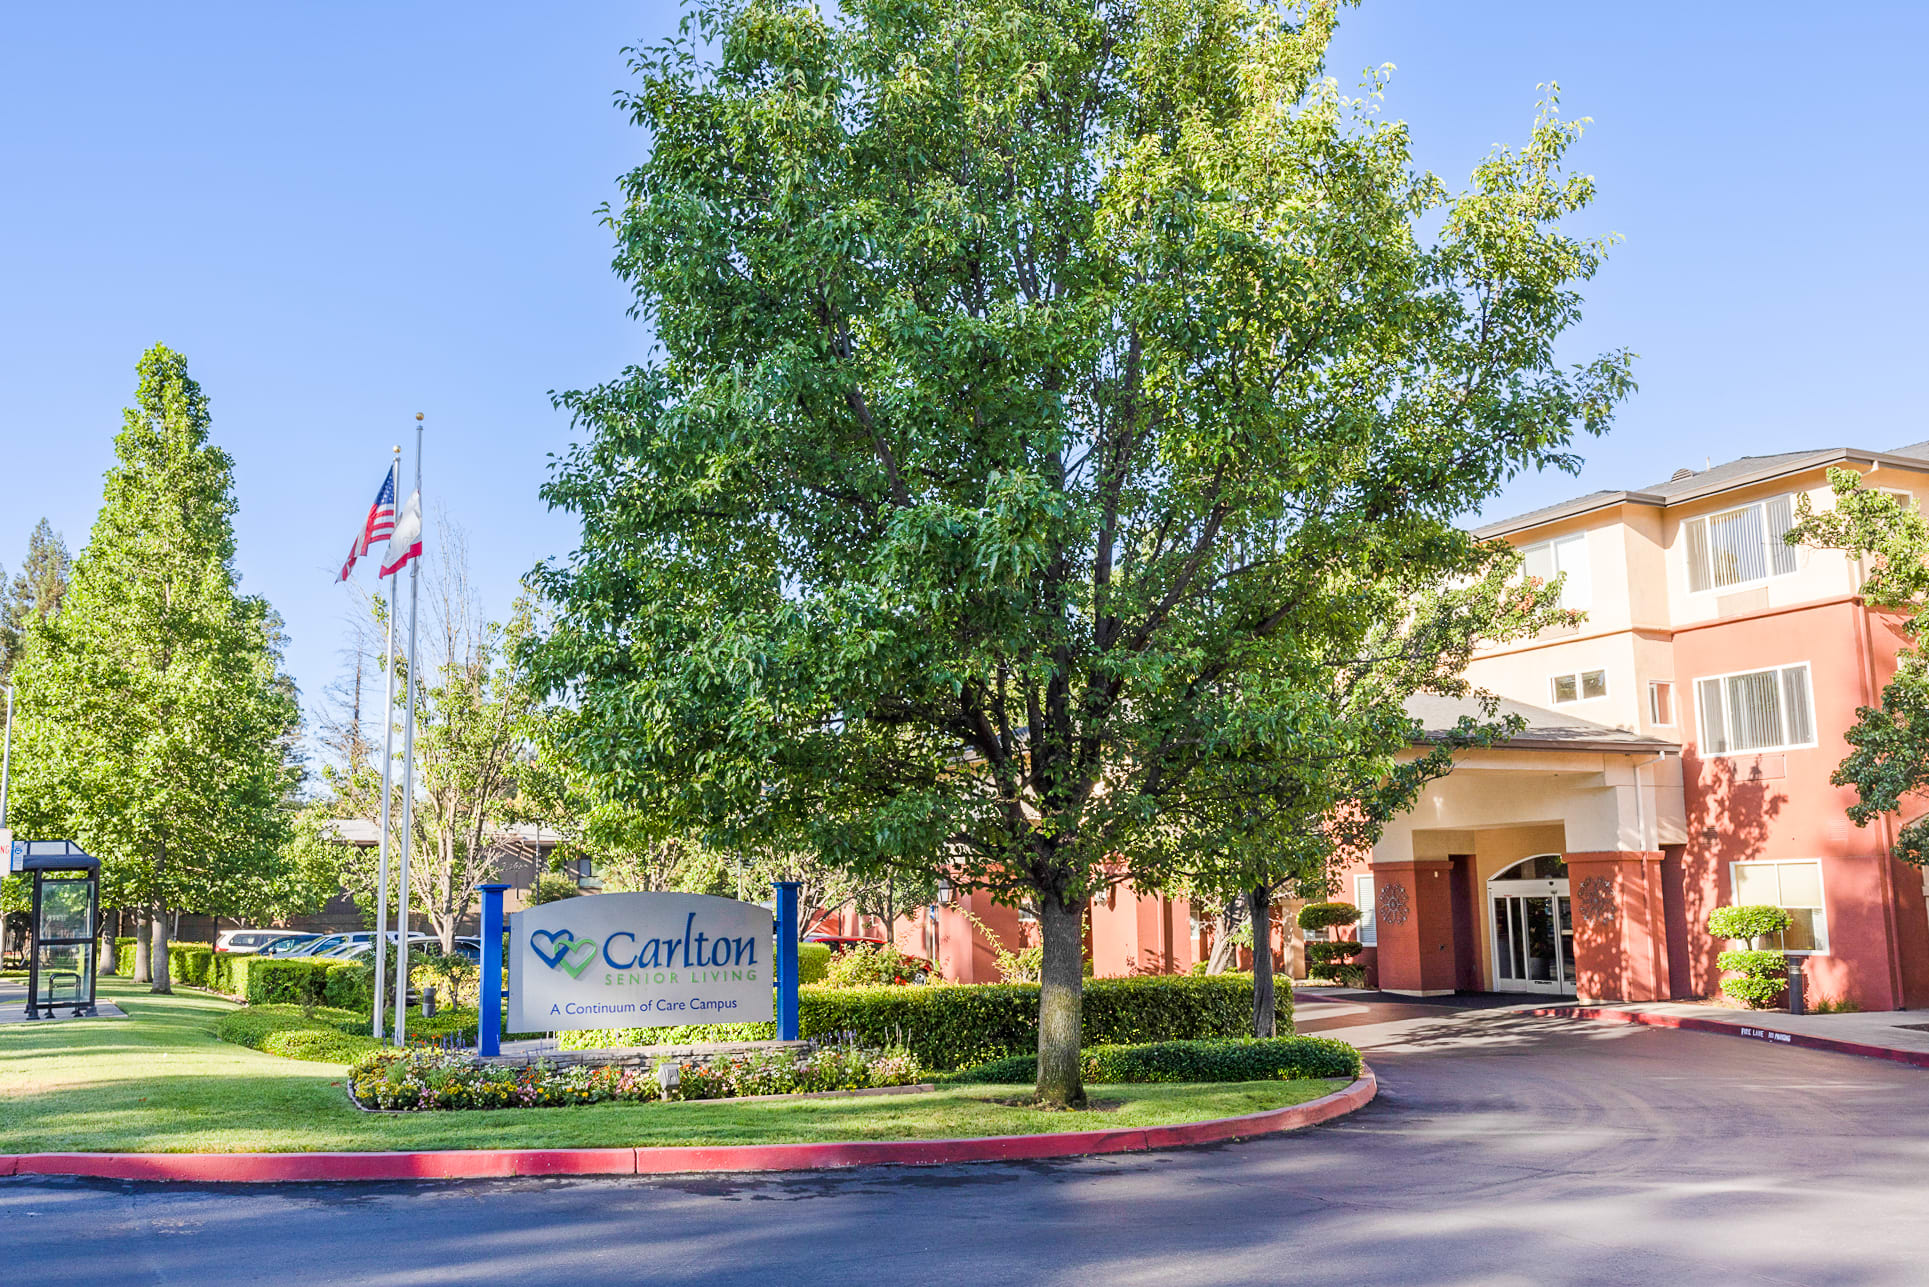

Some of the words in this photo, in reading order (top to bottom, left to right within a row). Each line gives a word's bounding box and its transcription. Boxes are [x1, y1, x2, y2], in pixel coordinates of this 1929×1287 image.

[602, 912, 758, 970] Carlton
[605, 972, 678, 986] SENIOR
[691, 969, 758, 984] LIVING
[550, 1003, 561, 1015] A
[565, 1002, 636, 1015] Continuum
[639, 999, 653, 1012] of
[656, 999, 686, 1012] Care
[689, 997, 738, 1012] Campus
